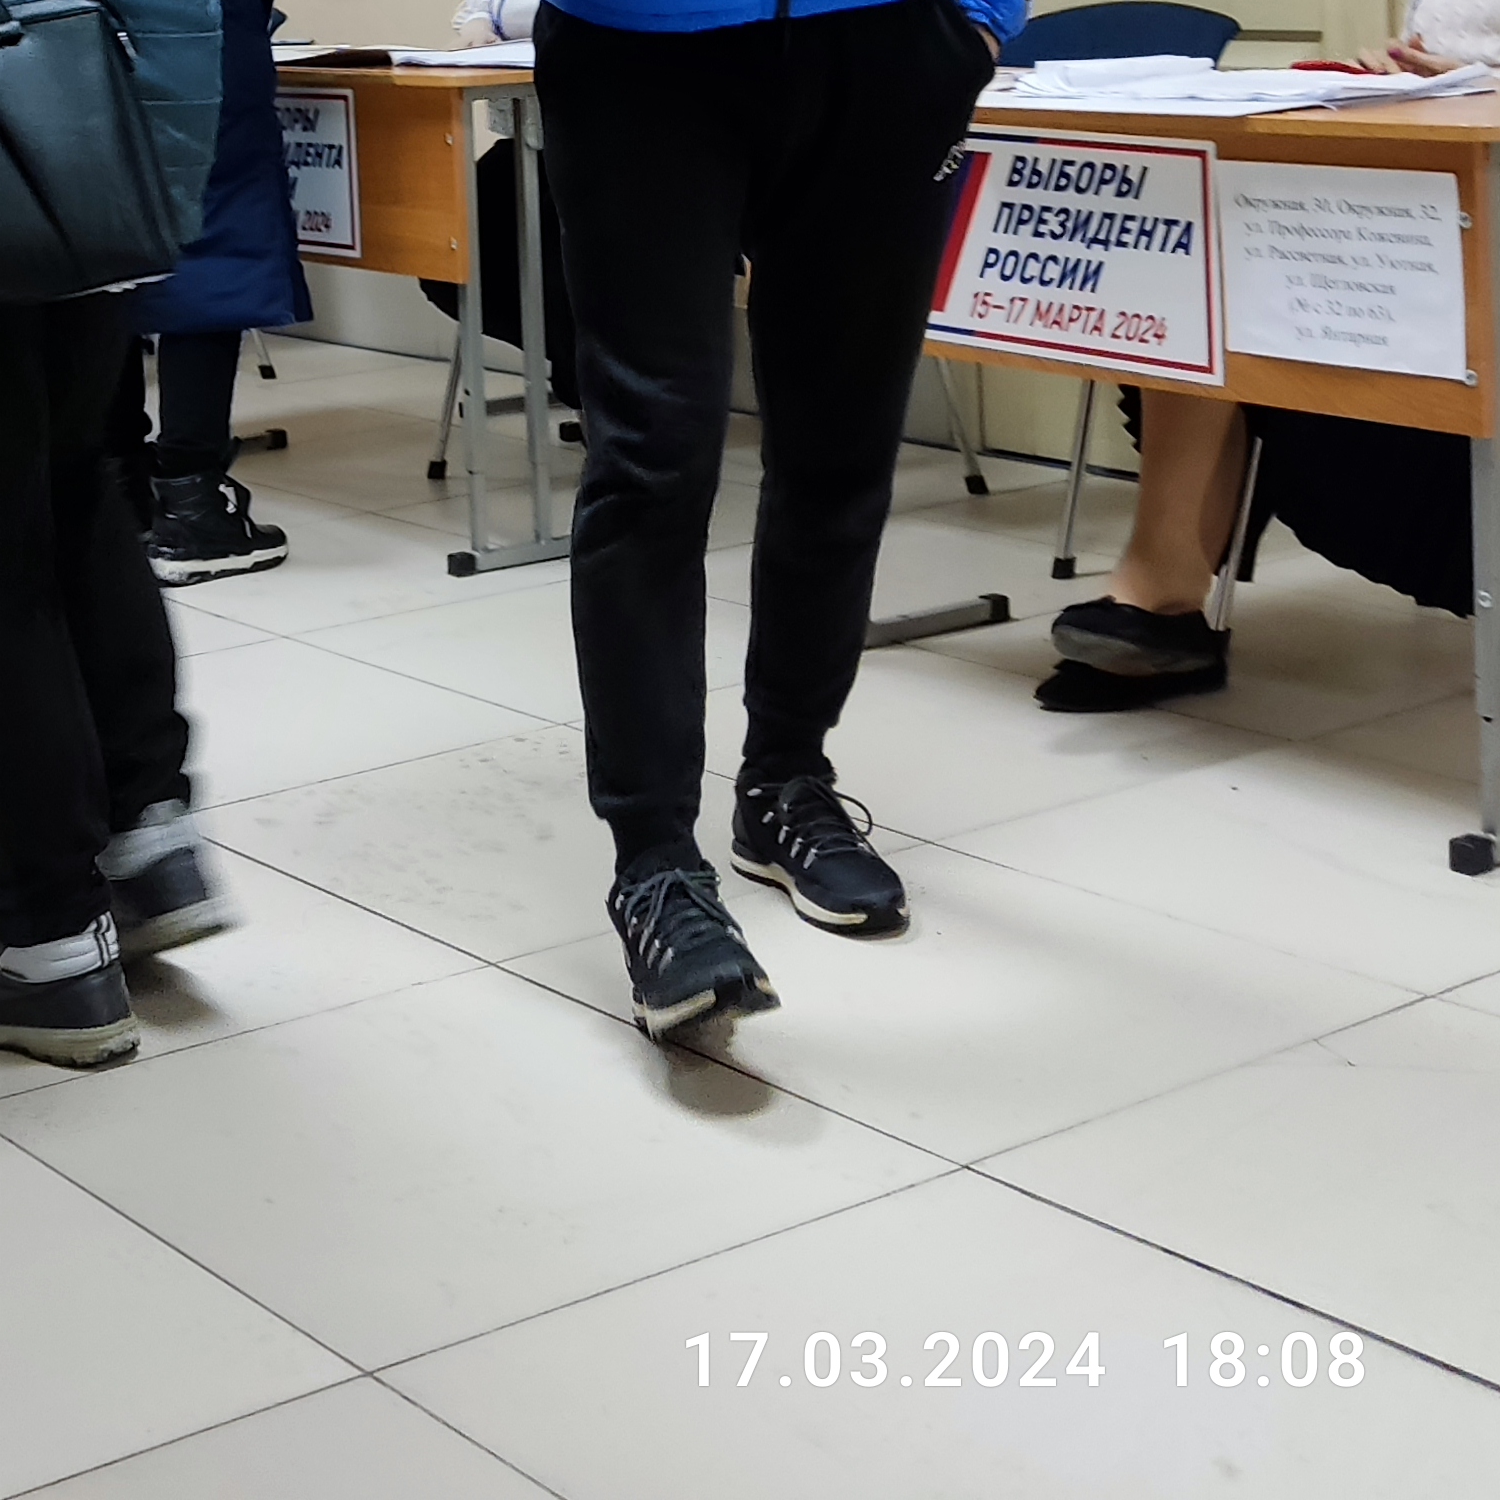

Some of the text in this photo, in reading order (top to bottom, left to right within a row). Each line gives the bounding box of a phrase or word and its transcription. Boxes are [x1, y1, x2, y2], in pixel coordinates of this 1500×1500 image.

[1005, 154, 1150, 201] ВЫБОРЫ
[991, 201, 1195, 256] ПРЕЗИДЕНТА
[978, 247, 1106, 294] РОССИИ
[1031, 301, 1107, 338] МАРТА
[1111, 311, 1168, 346] 2024
